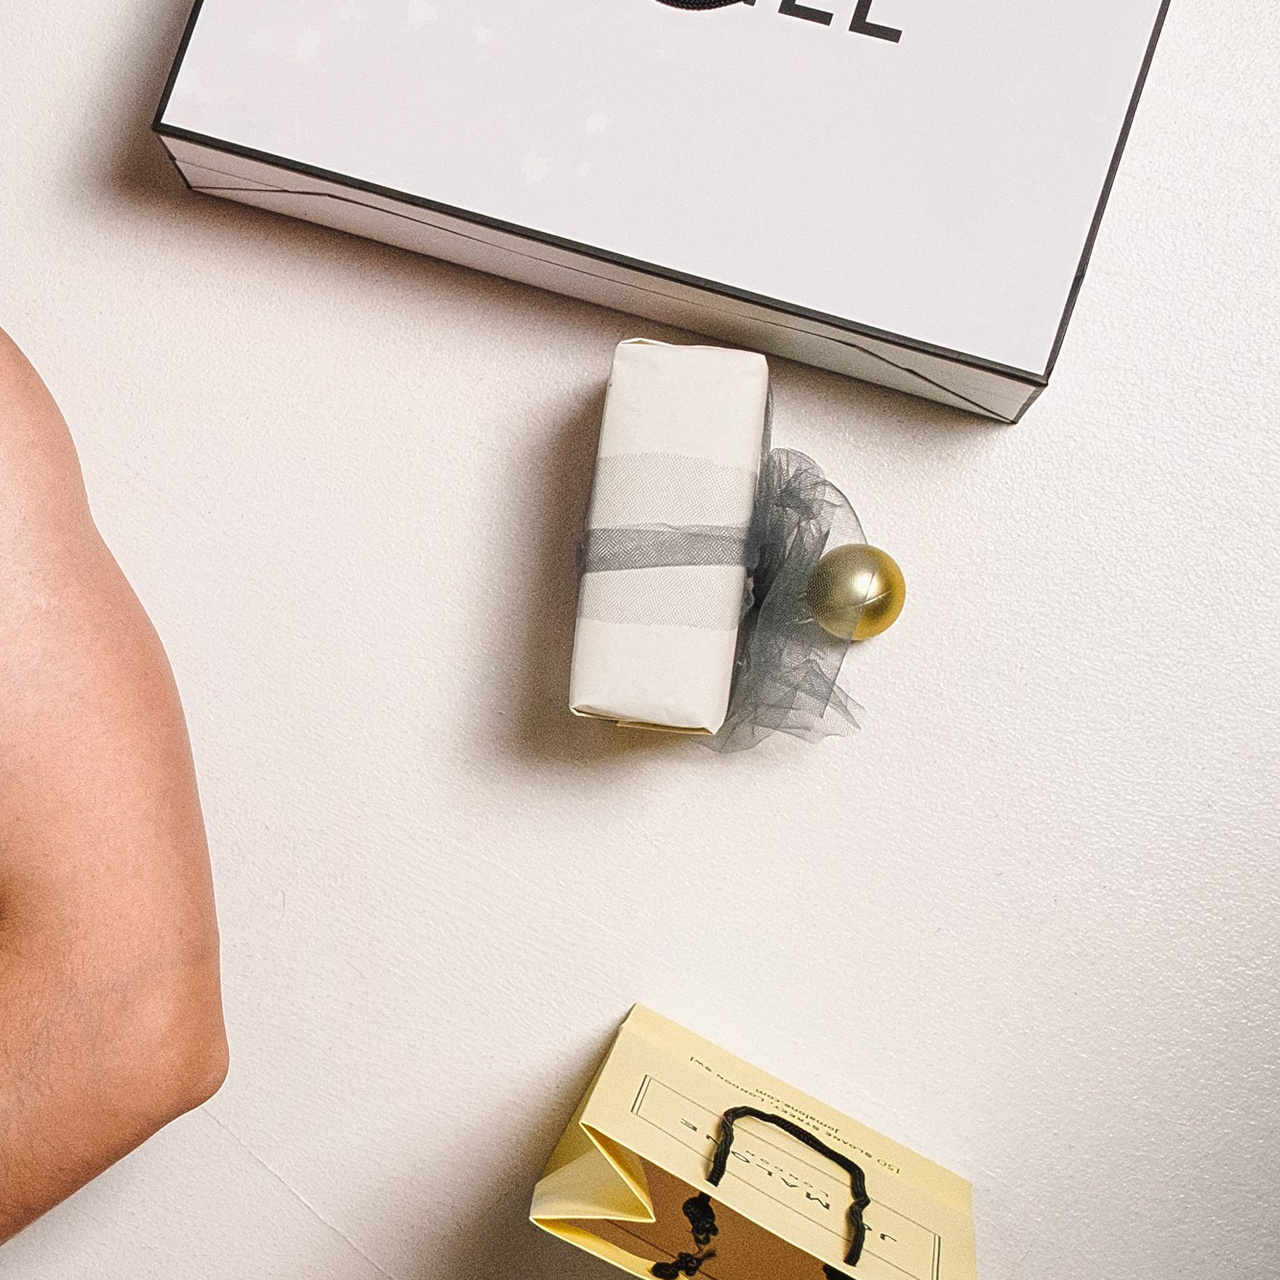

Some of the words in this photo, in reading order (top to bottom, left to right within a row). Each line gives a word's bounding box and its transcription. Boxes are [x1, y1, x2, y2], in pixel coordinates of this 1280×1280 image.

[716, 1074, 764, 1102] LONDON
[755, 1088, 840, 1133] jomalone.com
[825, 1130, 872, 1158] SLOANE
[745, 1150, 829, 1197] LONDON
[877, 1158, 900, 1174] 150
